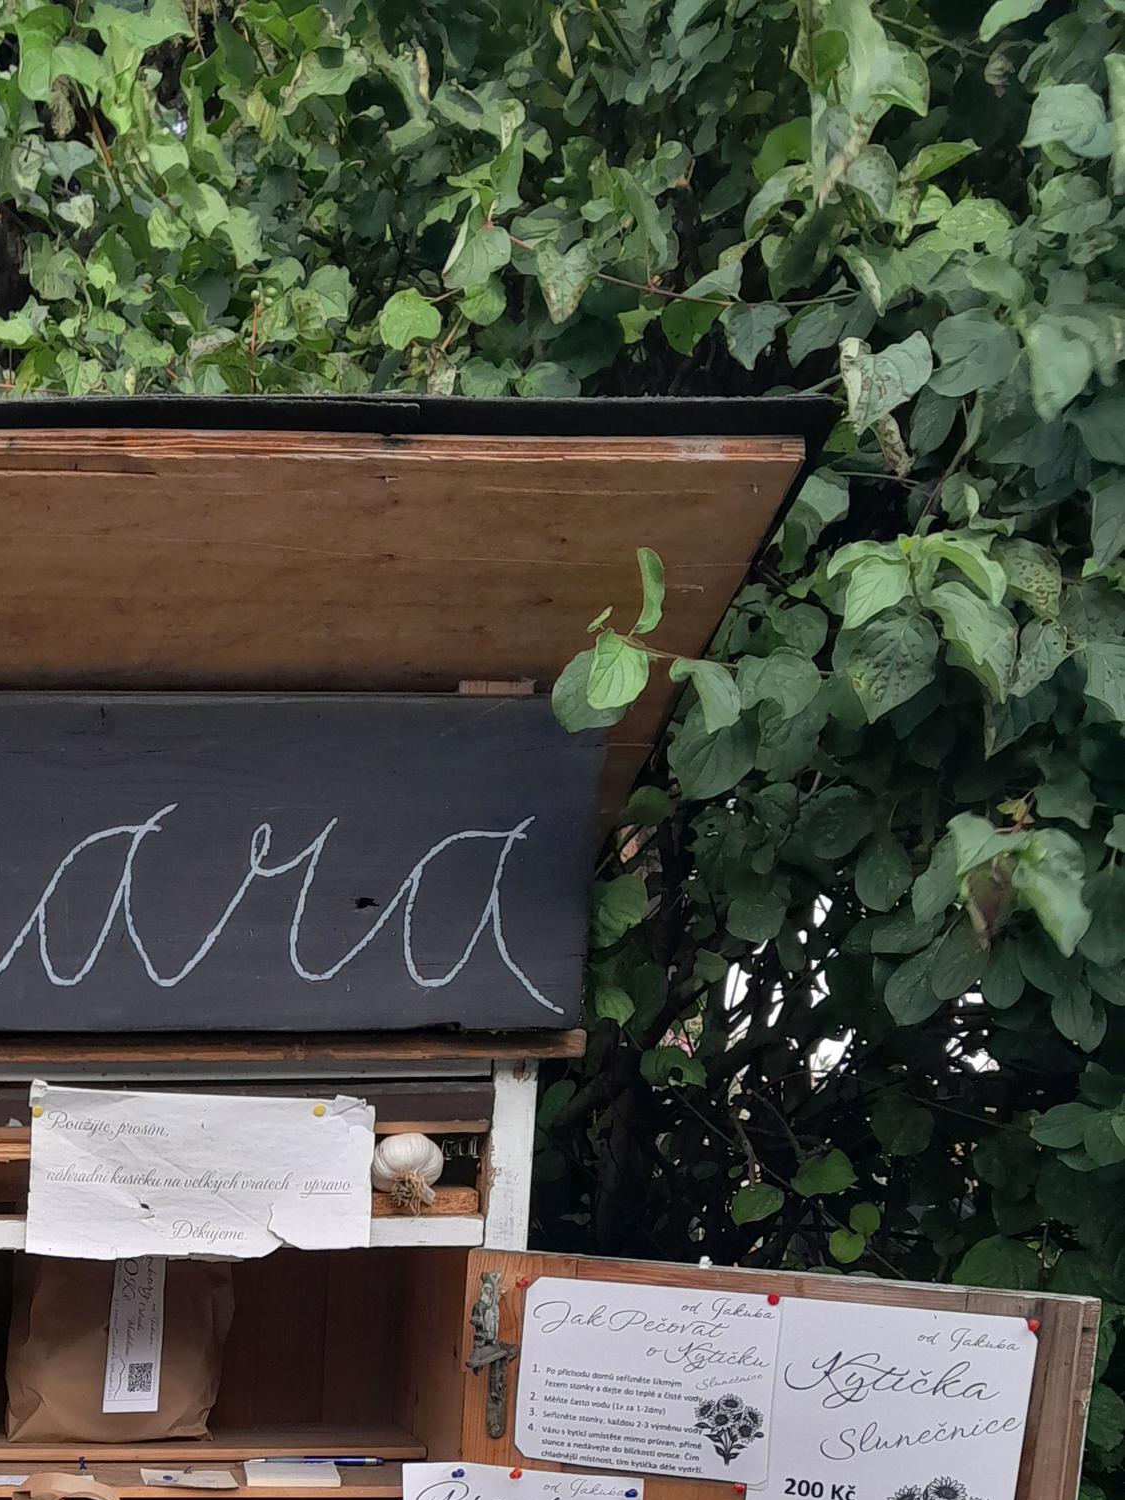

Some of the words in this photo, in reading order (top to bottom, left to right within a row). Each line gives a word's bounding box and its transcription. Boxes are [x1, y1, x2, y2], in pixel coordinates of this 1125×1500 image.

[107, 1121, 169, 1141] prosím,
[46, 1163, 110, 1183] náhradní
[110, 1165, 162, 1187] kasičku
[163, 1177, 181, 1188] na
[184, 1170, 238, 1195] velkých
[241, 1172, 294, 1190] vratech
[170, 1219, 247, 1243] Děkujeme.
[533, 1300, 610, 1334] Jak
[609, 1310, 730, 1338] Pečovat
[681, 1302, 699, 1315] od
[711, 1297, 774, 1320] Jakuba
[917, 1331, 941, 1345] od
[949, 1327, 1021, 1352] Jakuba
[664, 1342, 771, 1373] Kytičku
[784, 1351, 1001, 1409] Kytička
[819, 1416, 1023, 1461] Slunečnice
[542, 1481, 560, 1494] od
[569, 1478, 625, 1498] Jakuba
[783, 1477, 825, 1498] 200
